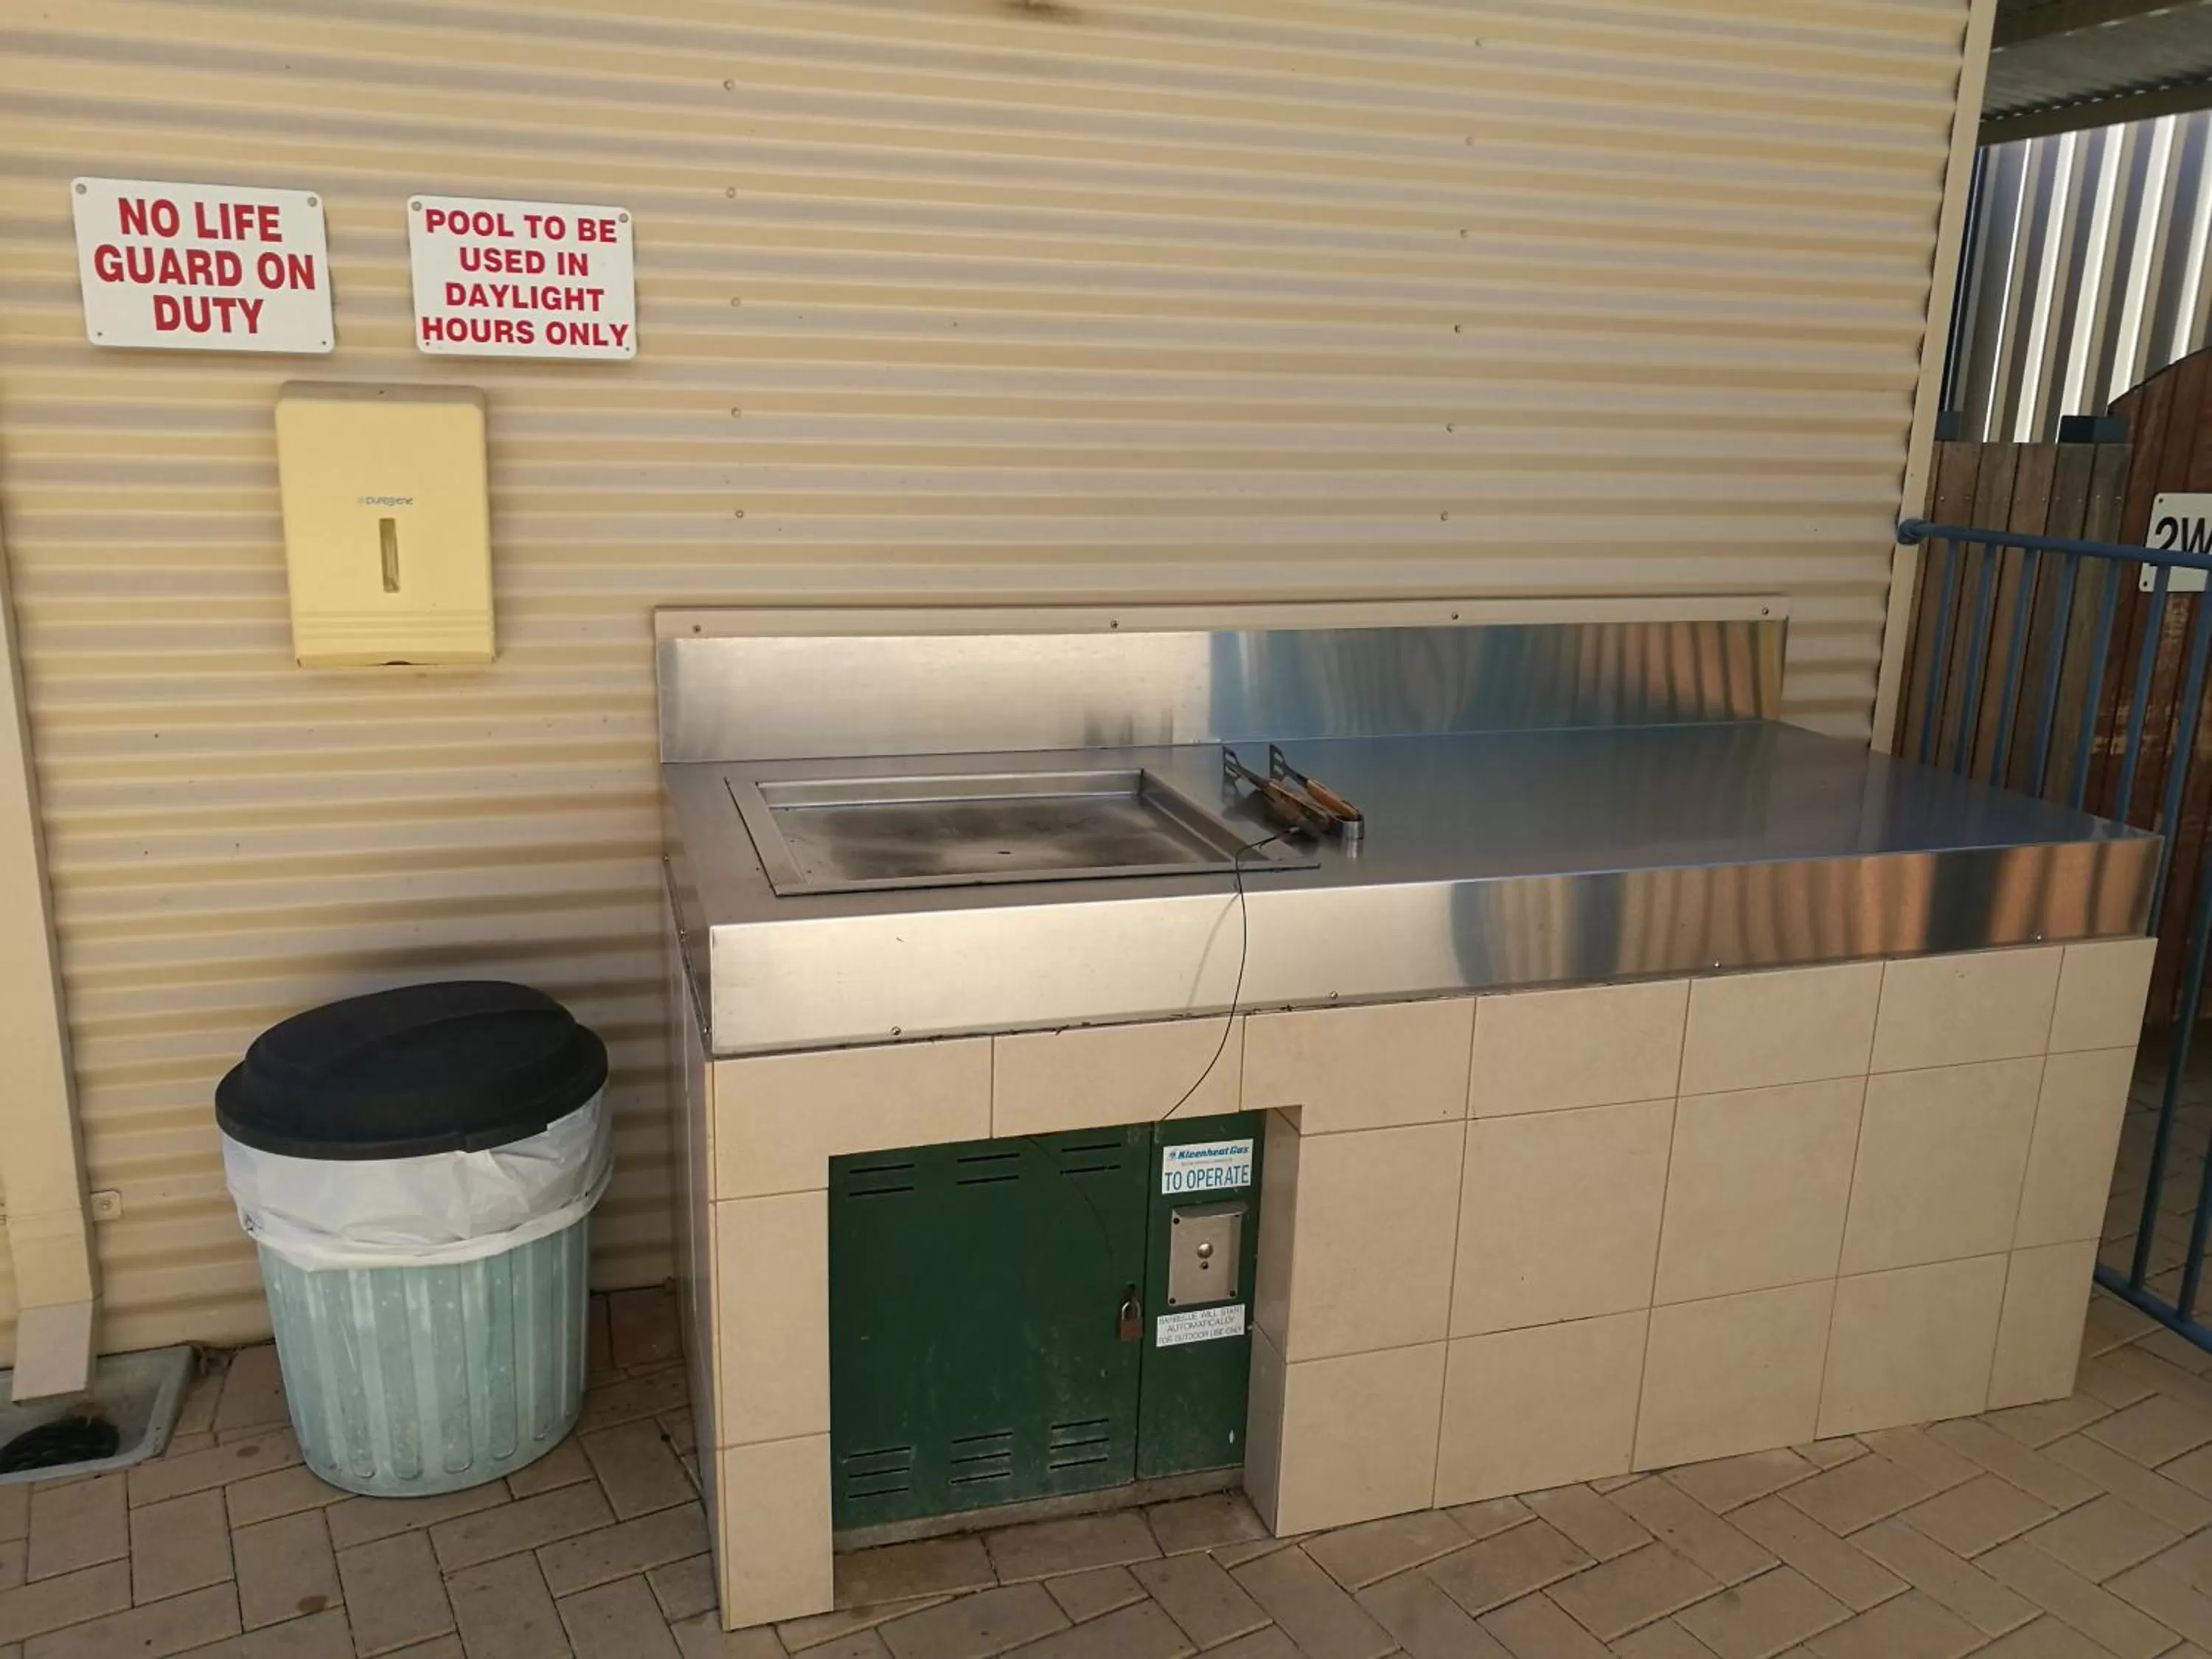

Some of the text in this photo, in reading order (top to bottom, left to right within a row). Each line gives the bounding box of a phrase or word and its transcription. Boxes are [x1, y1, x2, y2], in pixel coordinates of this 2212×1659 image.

[118, 198, 282, 243] NO LIFE
[425, 209, 616, 243] POOL TO BE
[94, 244, 316, 290] GUARD ON
[459, 247, 588, 276] USED IN
[445, 282, 605, 311] DAYLIGHT
[153, 295, 264, 333] DUTY
[422, 317, 628, 347] HOURS ONLY
[1164, 1165, 1250, 1192] TO OPERATE
